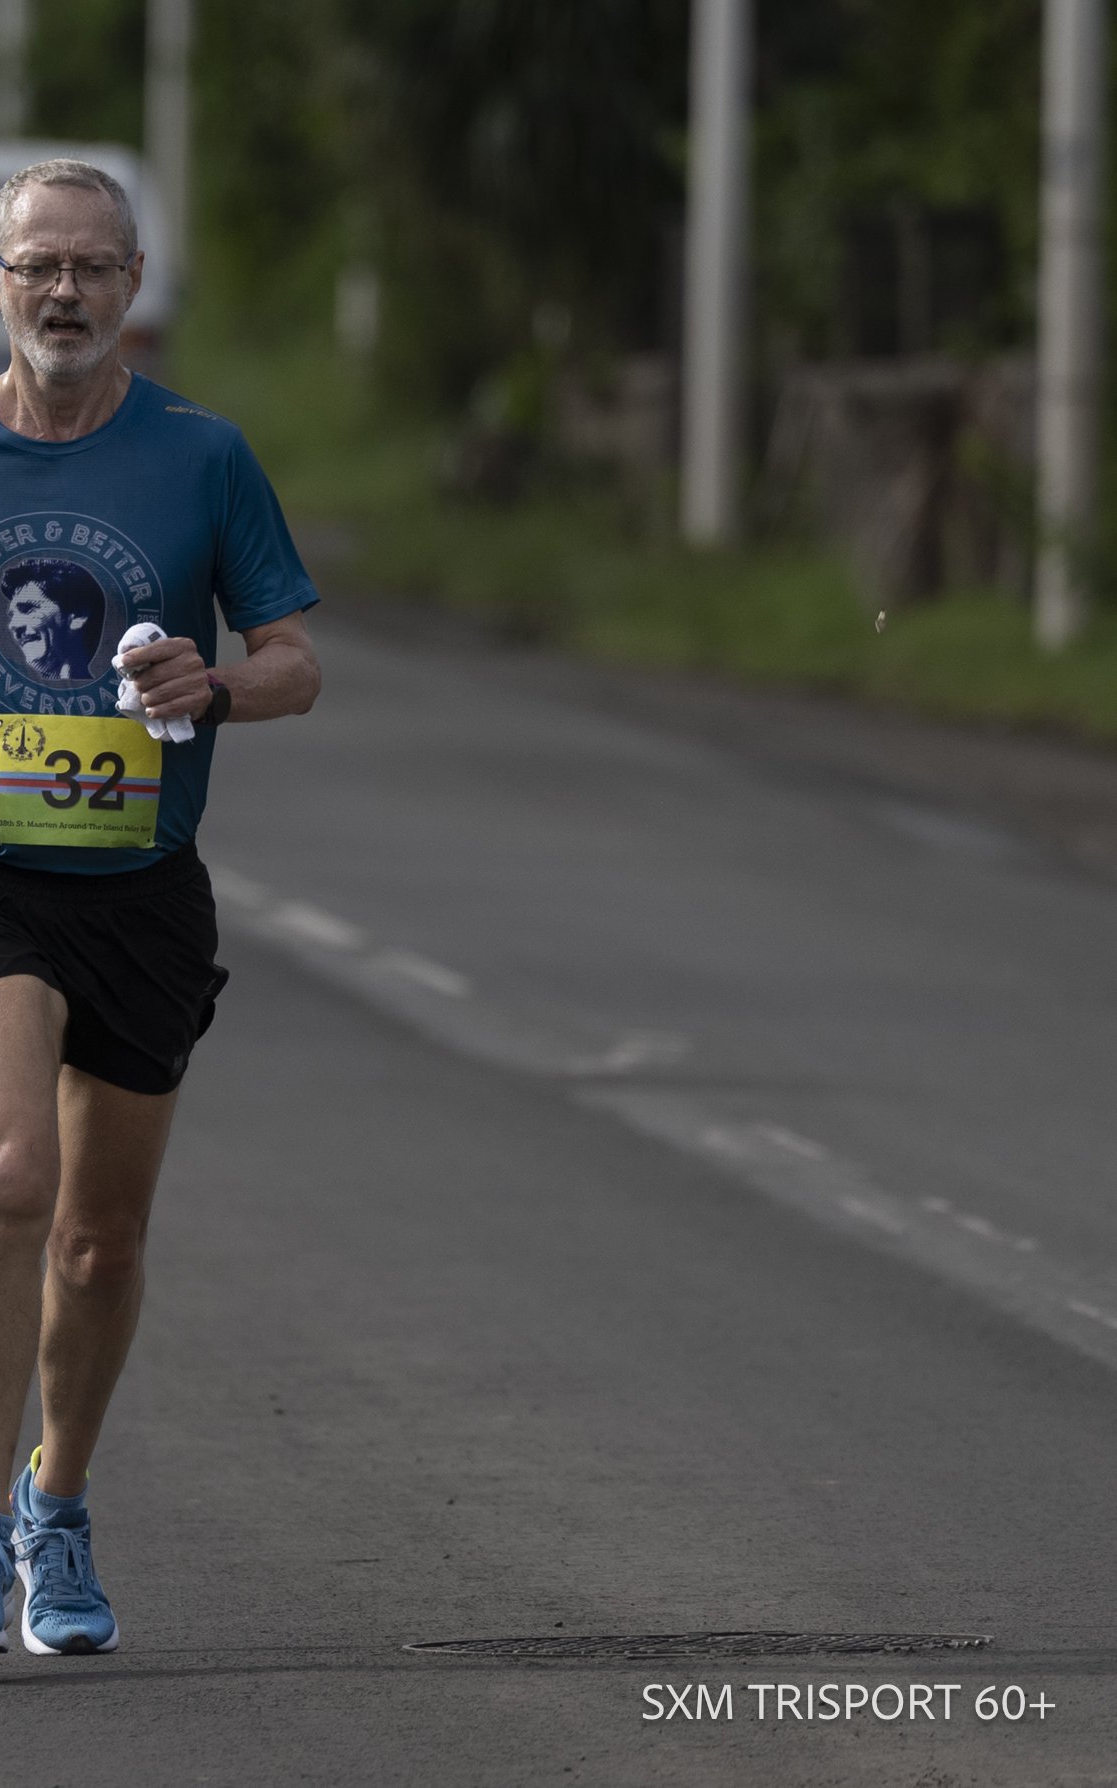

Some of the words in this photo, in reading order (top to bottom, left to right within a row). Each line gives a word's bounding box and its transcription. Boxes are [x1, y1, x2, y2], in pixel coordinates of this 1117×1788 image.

[44, 521, 63, 542] &
[71, 523, 152, 604] BETTER
[42, 749, 126, 811] 32
[27, 821, 58, 829] Maarten
[59, 822, 87, 830] Around
[88, 823, 102, 831] The
[103, 824, 123, 832] Island
